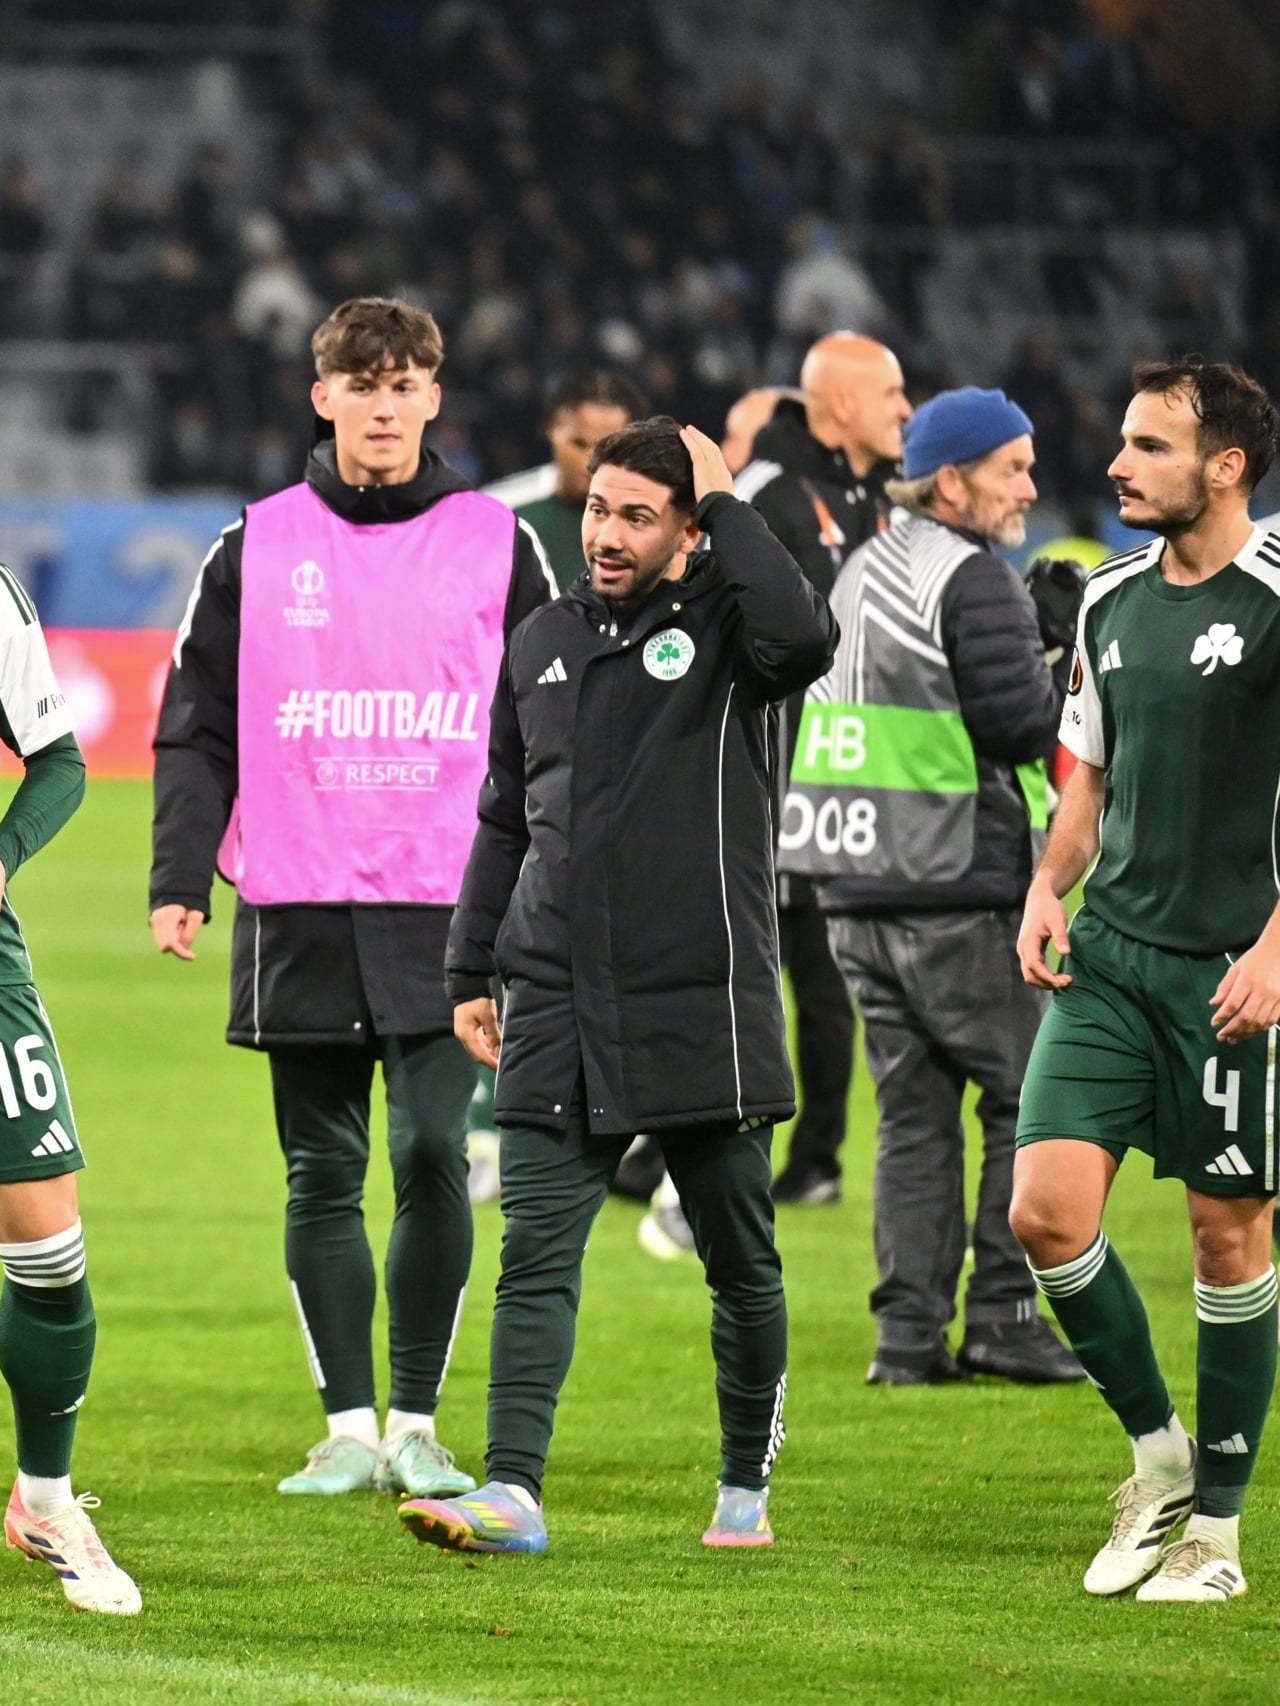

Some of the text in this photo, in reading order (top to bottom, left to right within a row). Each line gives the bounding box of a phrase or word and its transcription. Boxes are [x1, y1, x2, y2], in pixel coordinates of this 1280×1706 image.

[275, 690, 479, 741] #FOOTBALL
[804, 715, 866, 771] HB
[345, 764, 439, 785] RESPECT
[1202, 1056, 1240, 1131] 4
